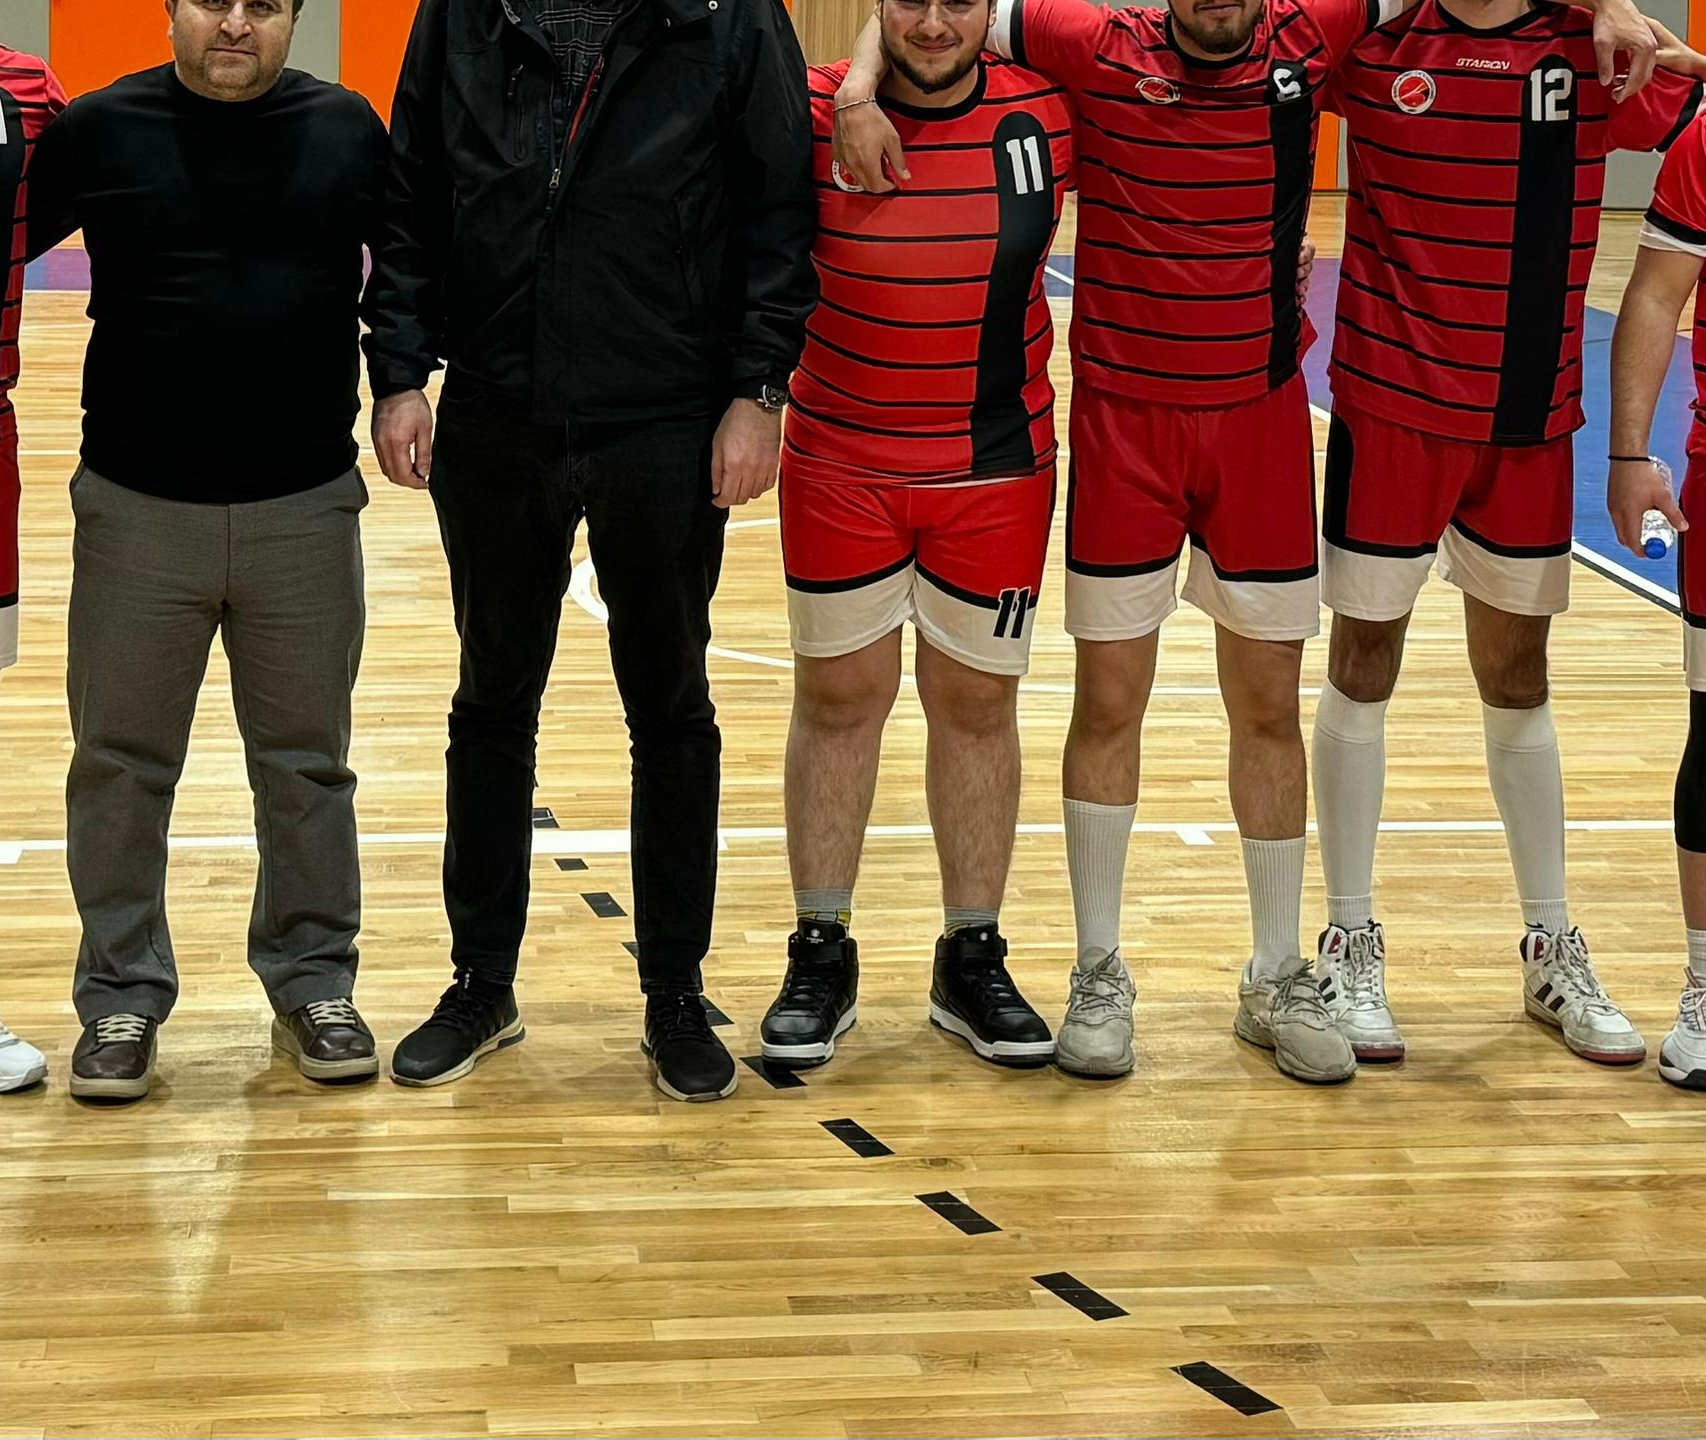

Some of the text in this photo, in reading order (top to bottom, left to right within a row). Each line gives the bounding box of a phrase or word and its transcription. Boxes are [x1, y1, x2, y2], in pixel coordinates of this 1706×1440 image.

[1529, 68, 1573, 122] 12
[1005, 135, 1045, 195] 11
[992, 587, 1032, 639] 11
